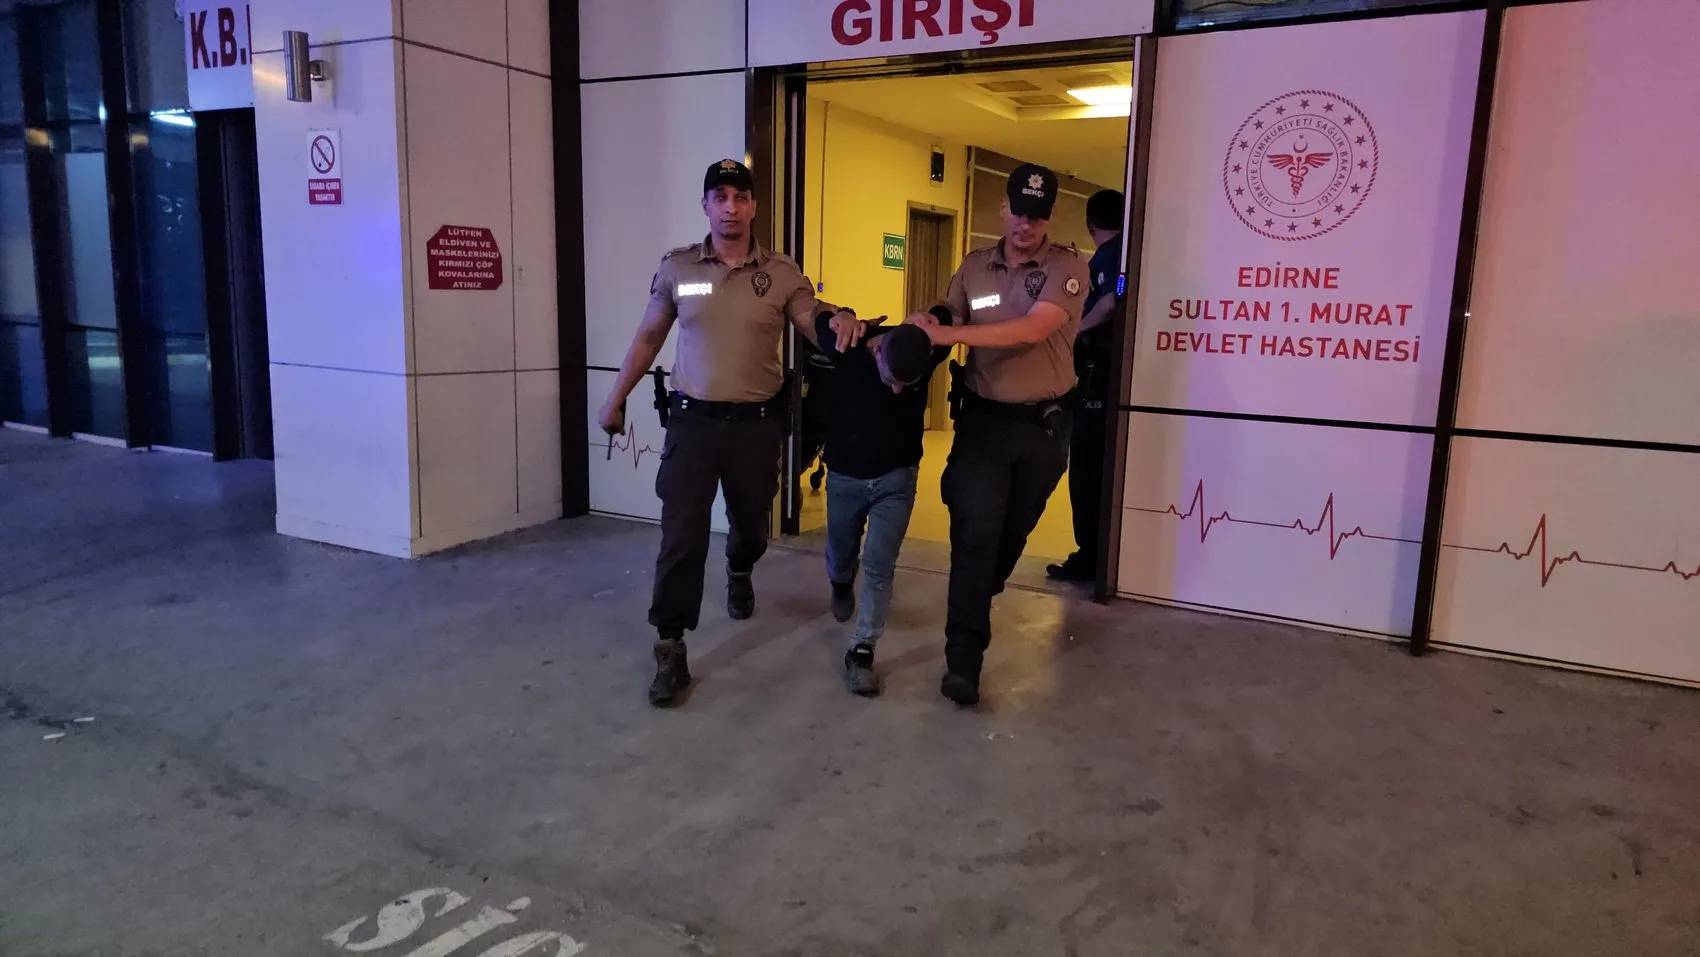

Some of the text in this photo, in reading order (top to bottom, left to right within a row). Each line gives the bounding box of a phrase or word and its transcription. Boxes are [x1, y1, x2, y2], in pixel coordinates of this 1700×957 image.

[190, 4, 252, 70] K.B.
[1315, 120, 1346, 149] SAĞLIK
[448, 228, 482, 238] LÜTFEN
[439, 238, 477, 247] ELDİVEN
[430, 248, 499, 259] MASKELERİNİZİ
[884, 243, 904, 260] KBRN
[438, 260, 494, 270] KIRMIZI ÇÖP
[438, 270, 495, 279] KOVALARINA
[1237, 261, 1341, 290] EDİRNE
[453, 281, 482, 289] ATINIZ
[1168, 299, 1414, 327] SULTAN 1. MURAT
[1155, 331, 1422, 364] DEVLET HASTANESİ
